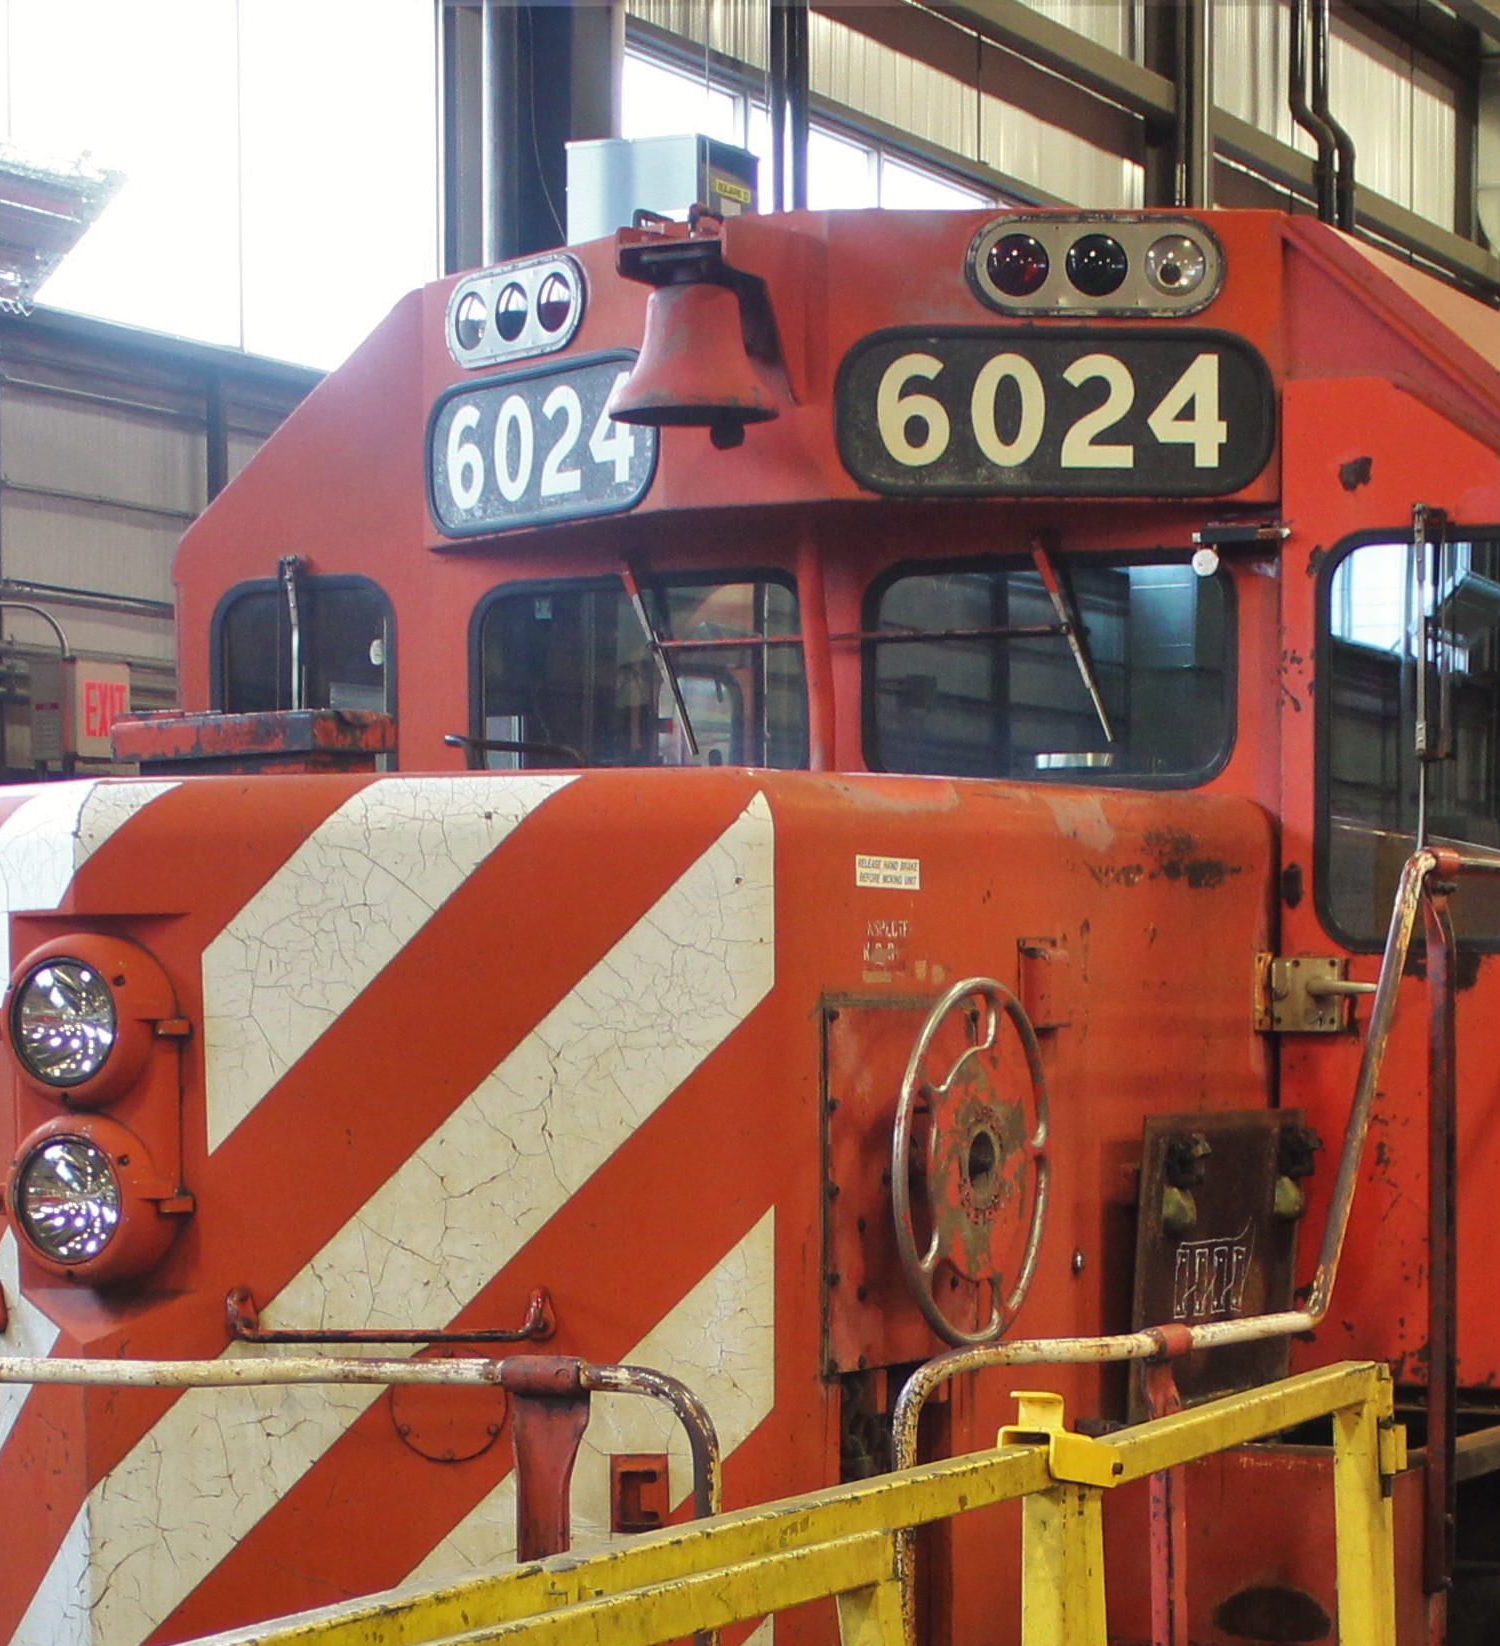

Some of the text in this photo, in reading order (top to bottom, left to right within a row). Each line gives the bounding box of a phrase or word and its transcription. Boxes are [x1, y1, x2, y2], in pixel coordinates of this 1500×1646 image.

[876, 353, 1227, 469] 6024
[447, 371, 635, 509] 6024
[84, 681, 127, 736] EXIT
[858, 858, 918, 872] RELEASE HAND BRAKE
[860, 871, 917, 885] BEFORE MOVING UNIT
